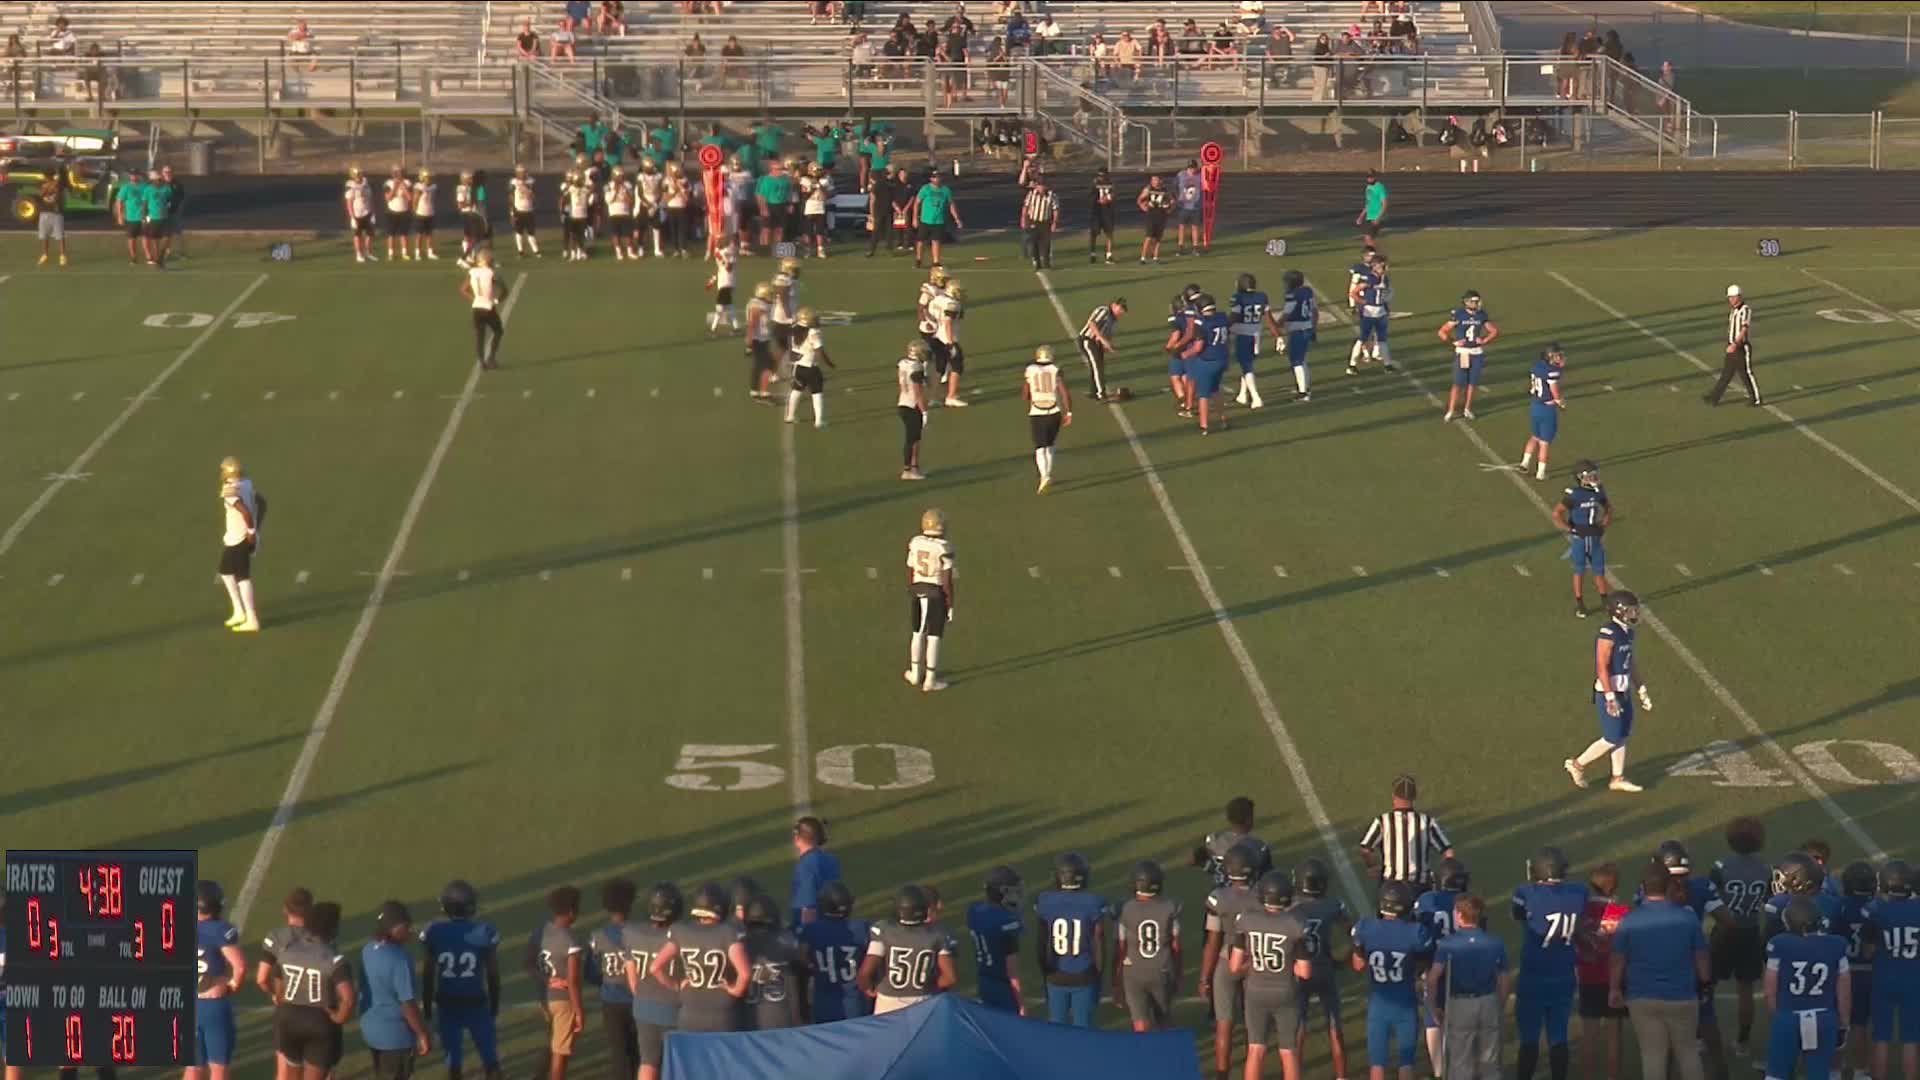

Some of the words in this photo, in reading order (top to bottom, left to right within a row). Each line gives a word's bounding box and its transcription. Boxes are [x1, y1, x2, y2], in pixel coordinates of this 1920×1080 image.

[1265, 239, 1286, 256] 40
[1760, 239, 1780, 256] 30
[1243, 304, 1261, 323] 55
[1465, 325, 1475, 342] 4
[664, 743, 936, 790] 50
[1052, 918, 1081, 955] 81
[1138, 919, 1160, 958] 8
[1545, 912, 1577, 948] 74
[1884, 927, 1920, 959] 45
[439, 952, 477, 978] 22
[815, 946, 857, 984] 43
[888, 946, 934, 990] 50
[1249, 931, 1287, 973] 15
[282, 964, 322, 1002] 71
[1789, 961, 1828, 996] 32
